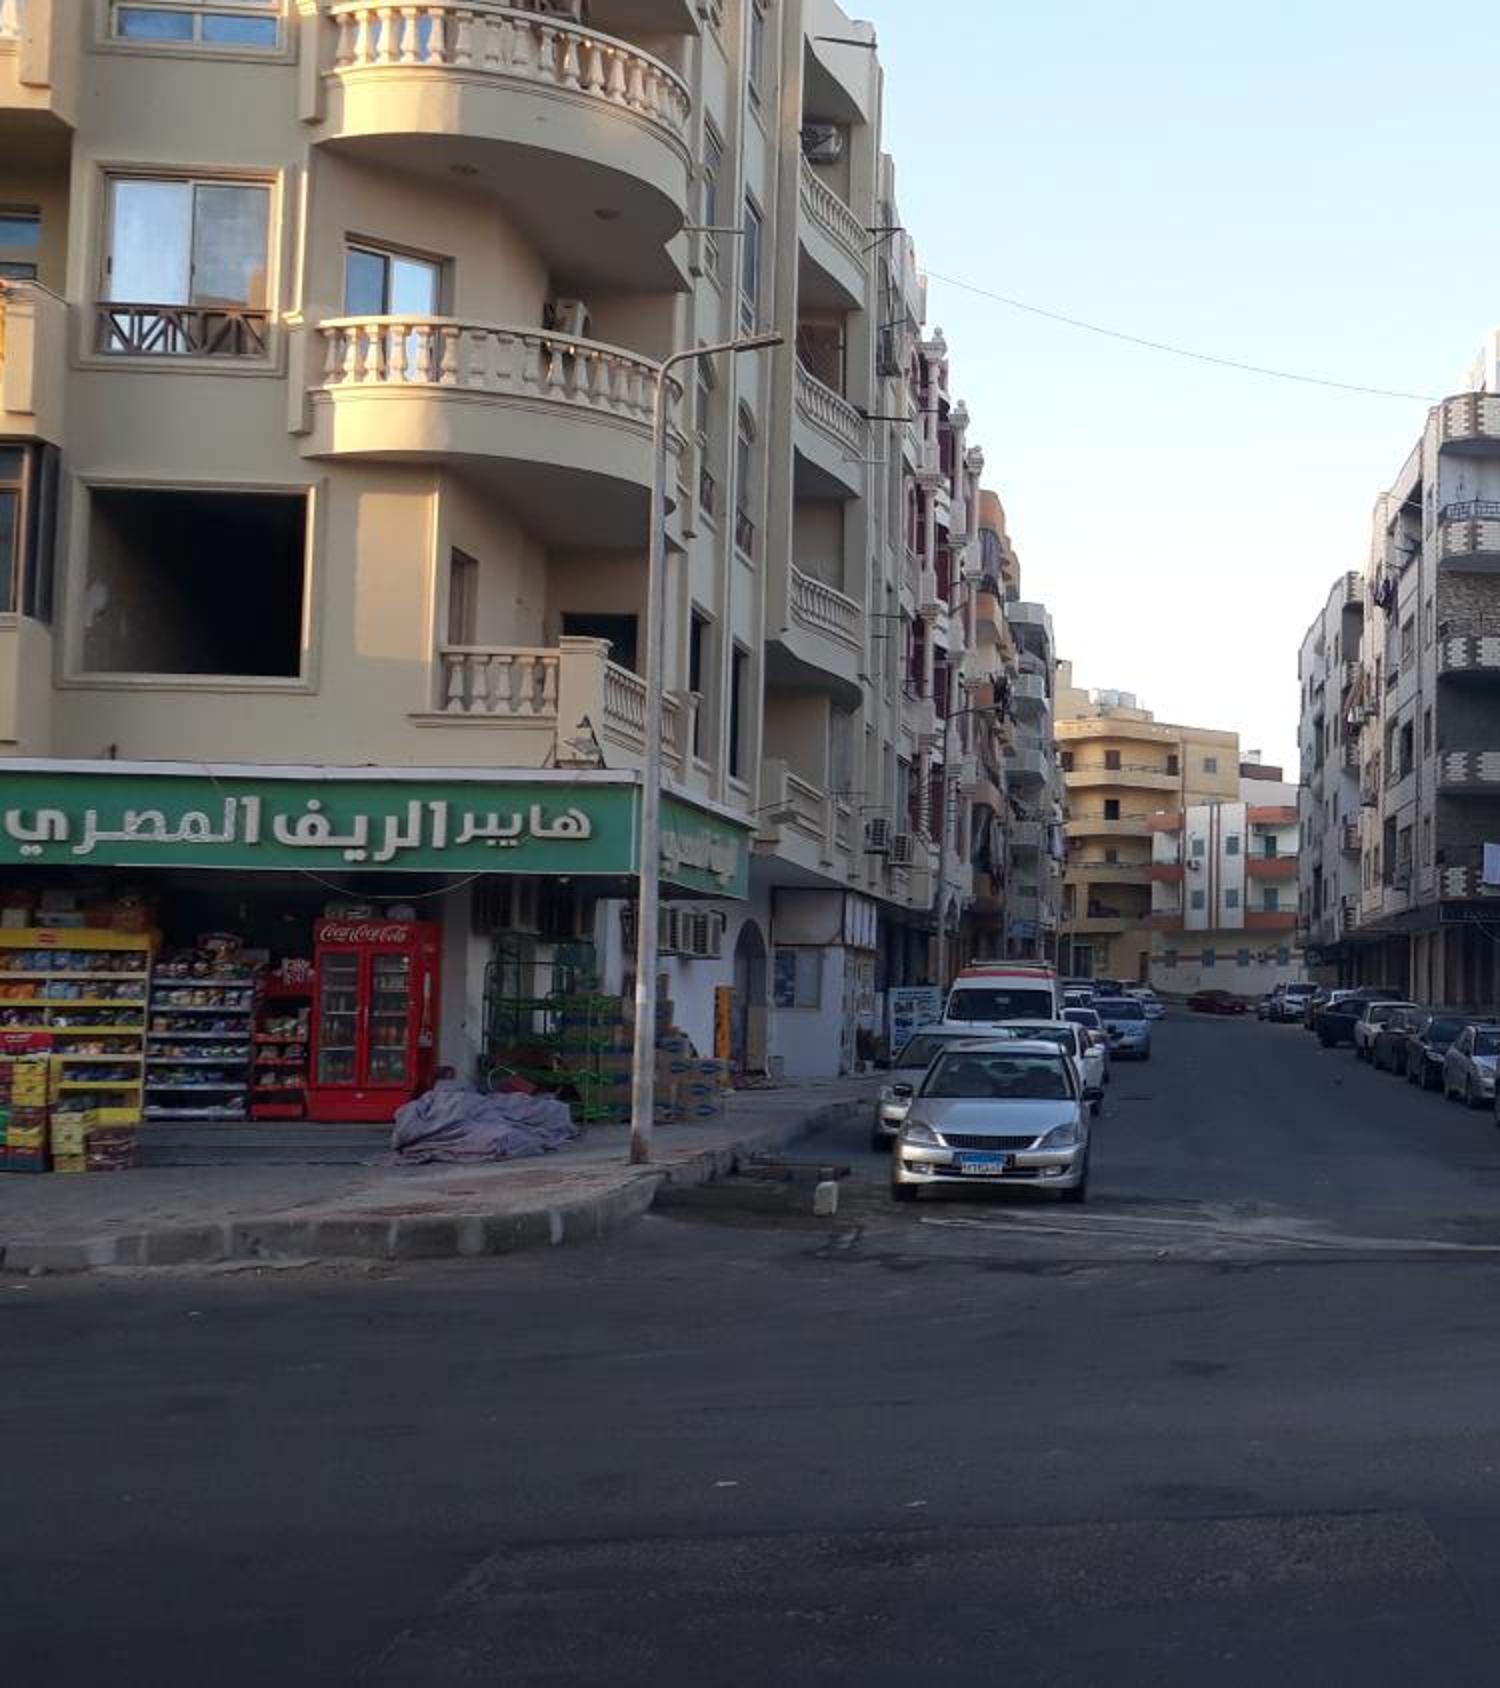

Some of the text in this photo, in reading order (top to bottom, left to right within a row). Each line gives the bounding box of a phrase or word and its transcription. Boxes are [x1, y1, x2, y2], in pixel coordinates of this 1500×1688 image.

[4, 795, 593, 862] هايبر الريف المصري
